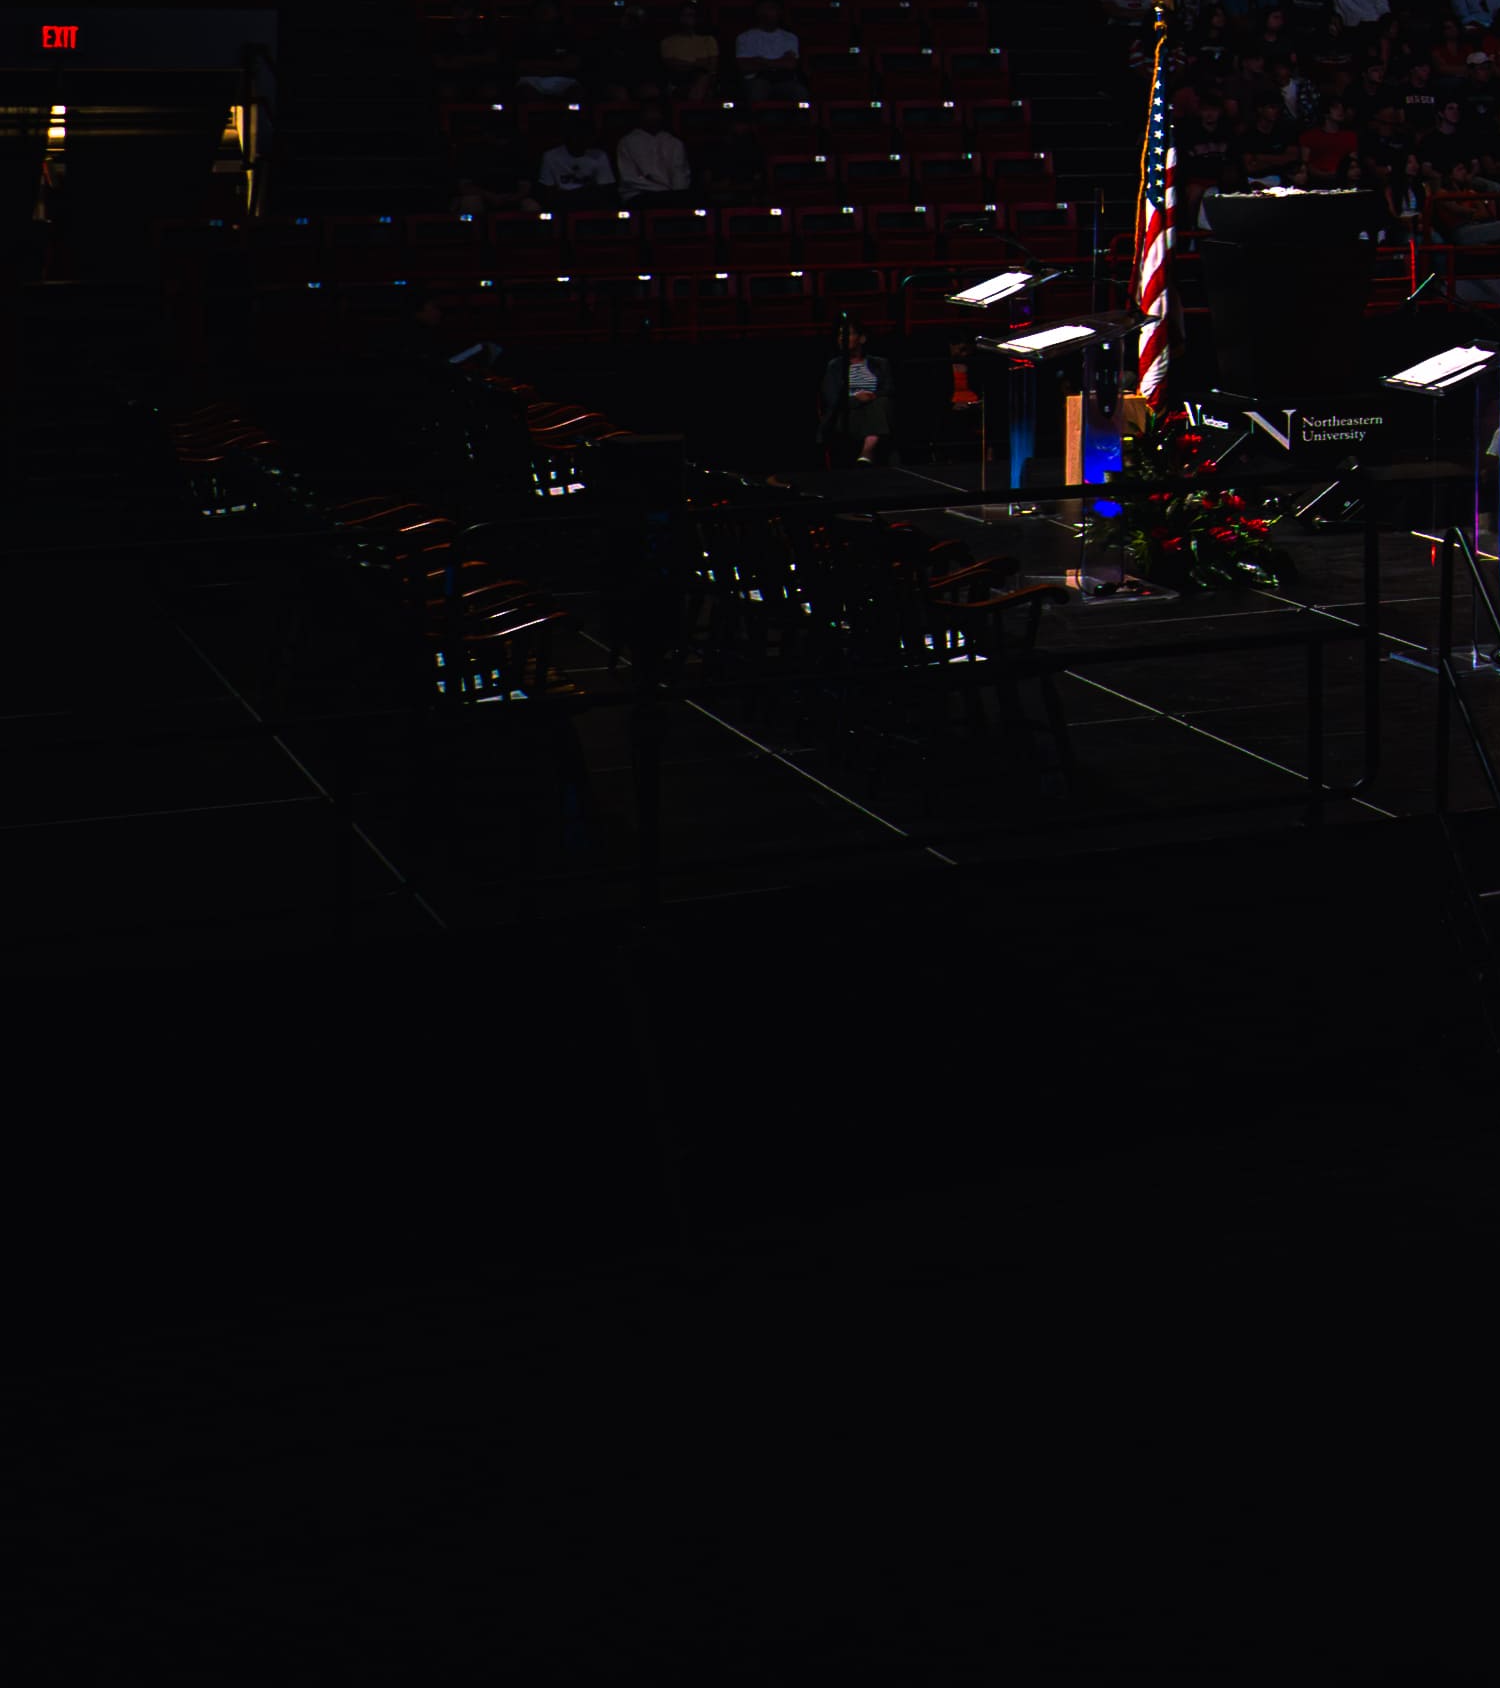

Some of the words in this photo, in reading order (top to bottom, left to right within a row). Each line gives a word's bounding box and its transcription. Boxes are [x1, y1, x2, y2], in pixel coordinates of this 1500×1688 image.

[42, 25, 79, 49] EXIT
[1302, 415, 1384, 429] Northeastern
[1302, 429, 1367, 443] University
